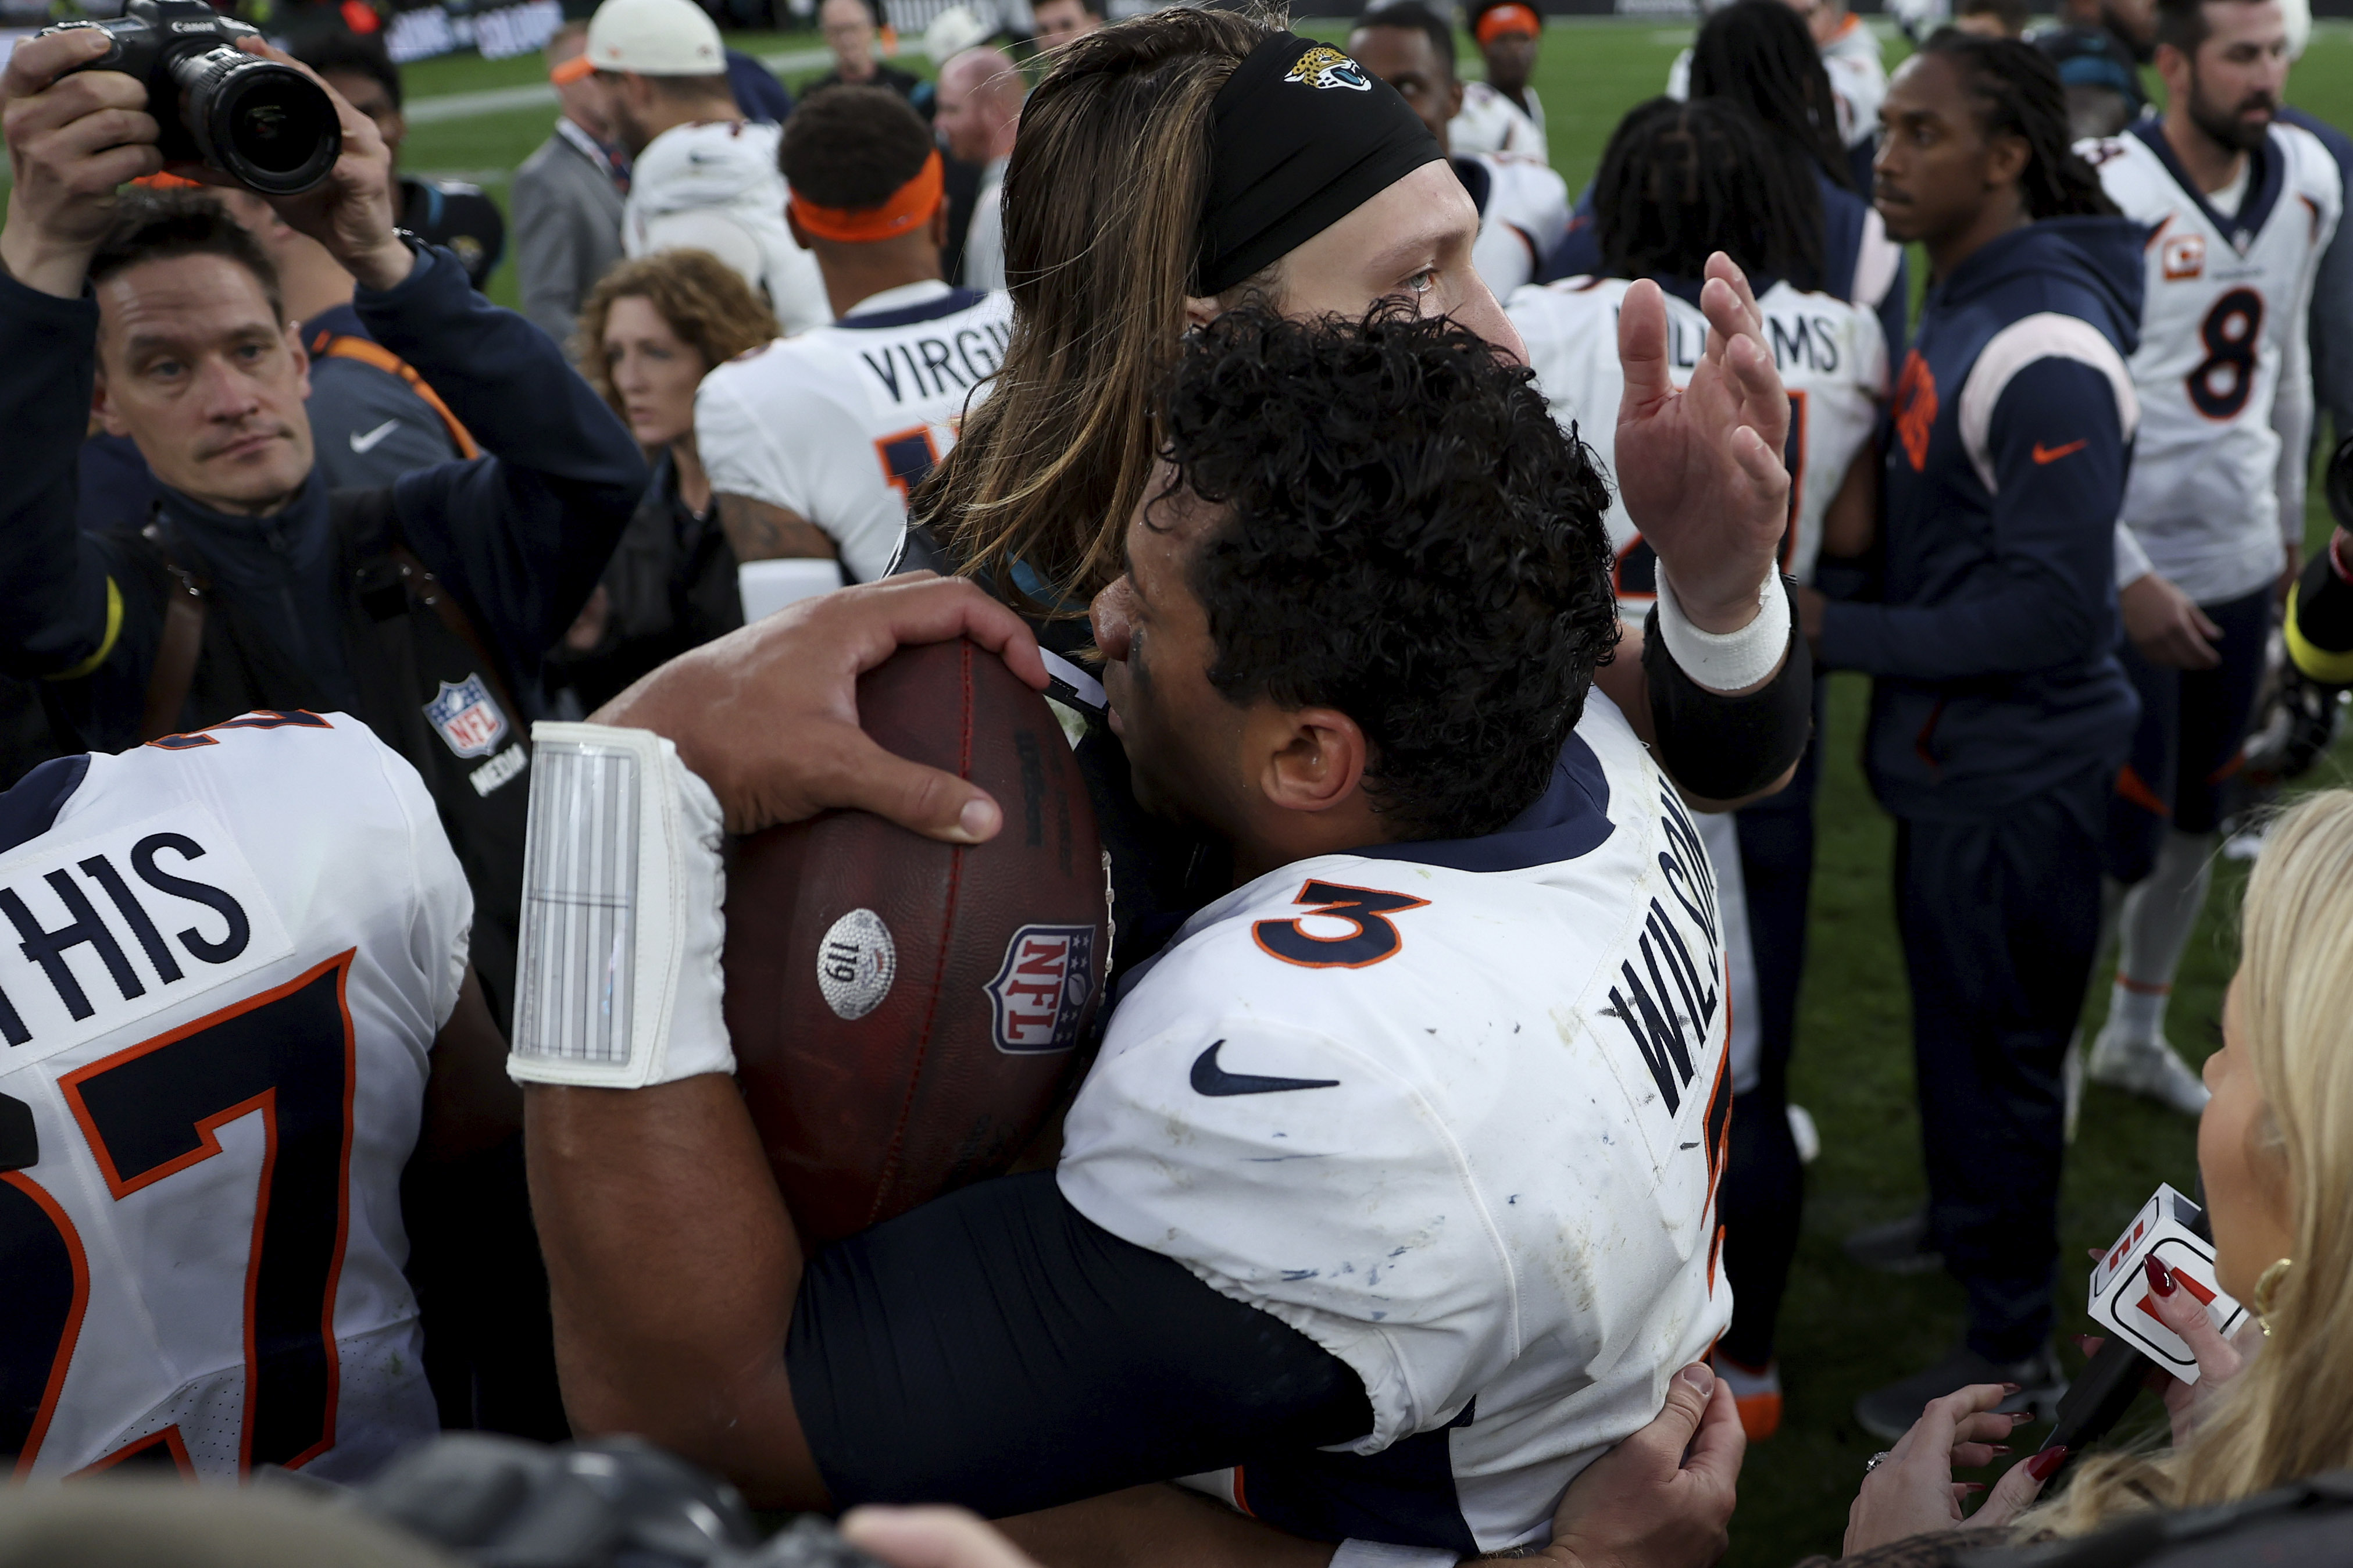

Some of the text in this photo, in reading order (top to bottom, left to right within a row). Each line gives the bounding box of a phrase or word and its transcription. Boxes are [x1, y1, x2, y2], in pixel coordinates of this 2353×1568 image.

[2184, 285, 2265, 425] 8
[447, 705, 499, 749] NFL
[824, 942, 859, 983] 119
[1251, 878, 1433, 970] 3
[1608, 773, 1719, 1119] WILSON
[1006, 940, 1067, 1040] NFL
